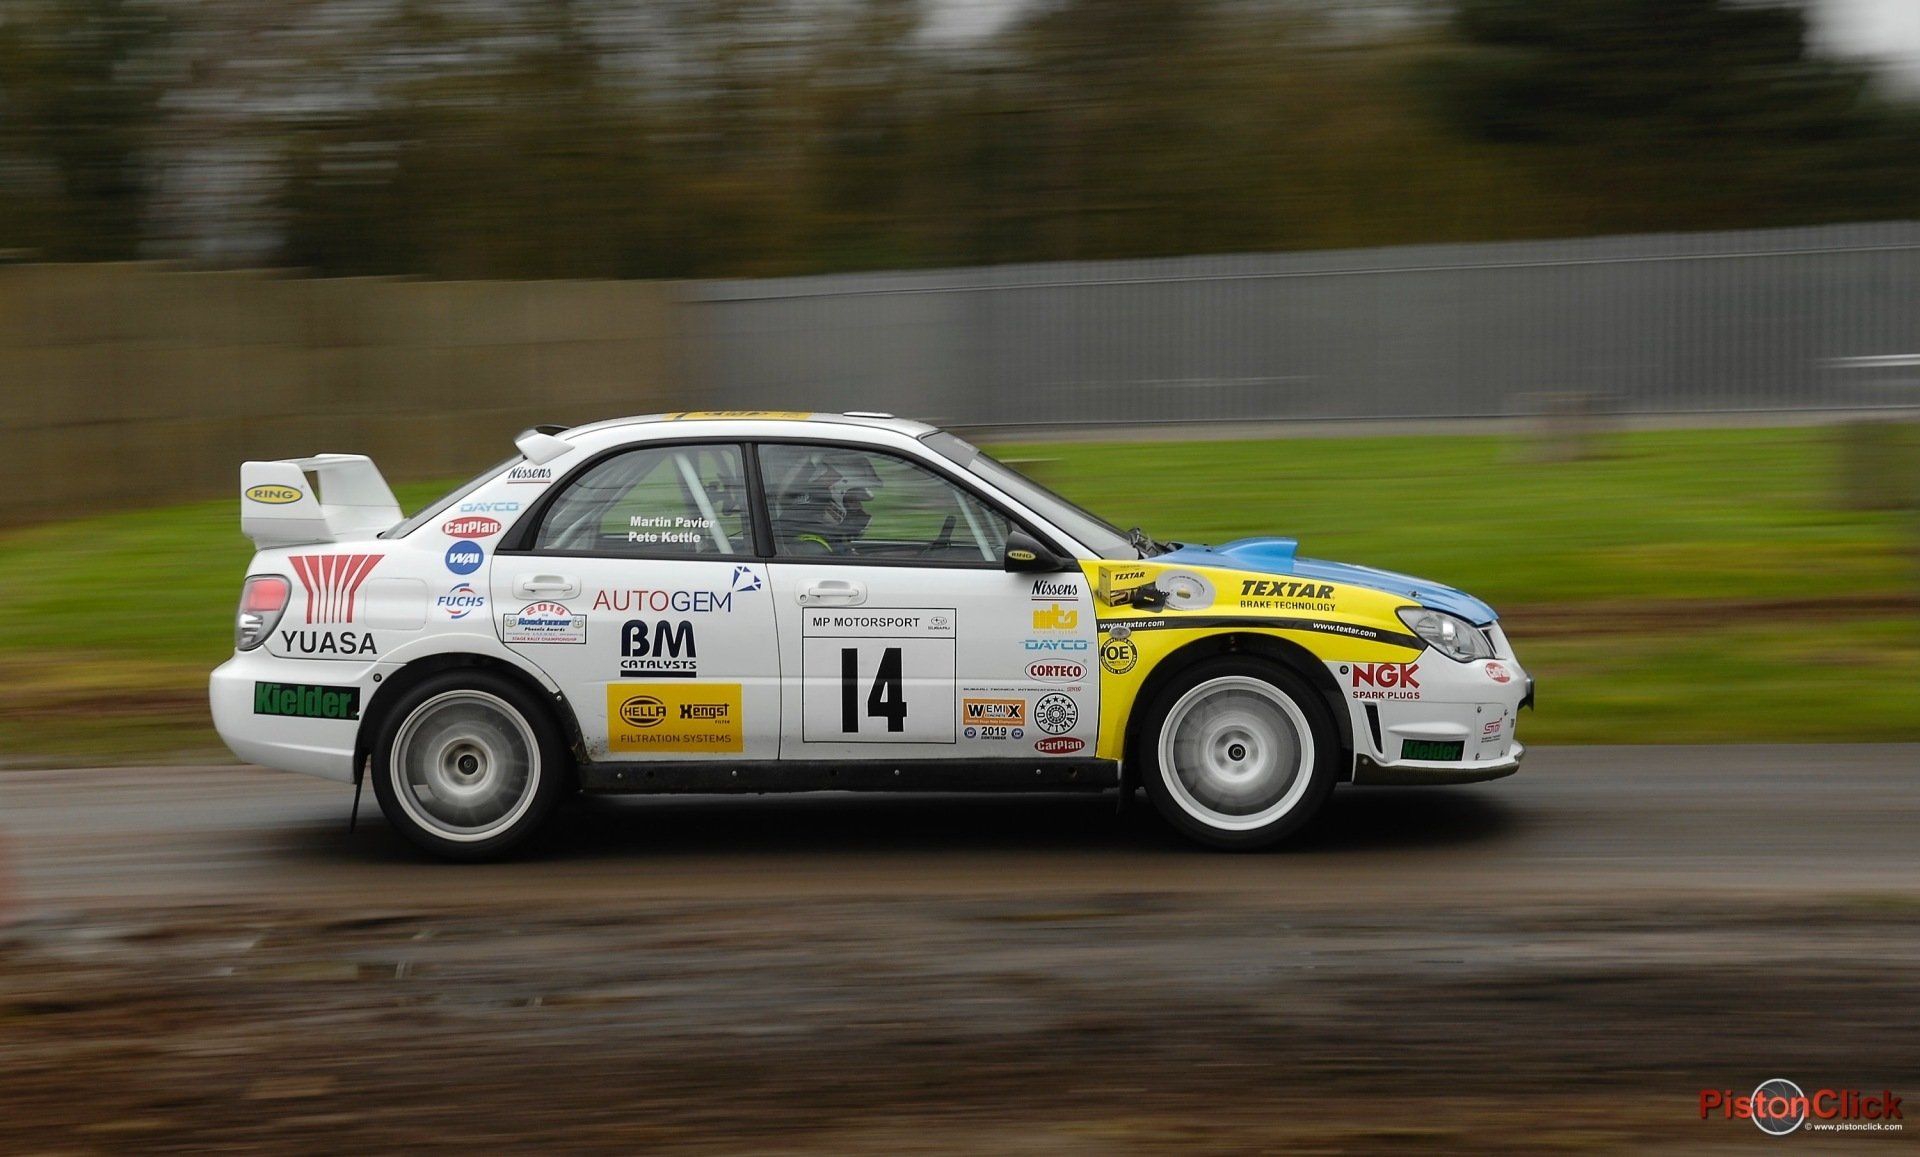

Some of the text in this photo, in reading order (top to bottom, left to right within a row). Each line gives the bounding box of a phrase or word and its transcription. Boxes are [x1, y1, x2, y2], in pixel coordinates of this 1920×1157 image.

[508, 467, 551, 480] Nissens
[254, 490, 294, 500] RING
[460, 502, 519, 513] DAYCO
[444, 519, 499, 536] CarPlan
[630, 516, 716, 529] Martin Pavier
[628, 531, 701, 543] Pete Kettle
[450, 552, 479, 565] WAI
[1011, 551, 1033, 559] RING
[1115, 571, 1146, 580] TEXTAR
[1031, 579, 1078, 596] Nissens
[1241, 580, 1334, 599] TEXTAR
[437, 596, 484, 607] FUCHS
[593, 590, 732, 612] AUTOGEM
[1240, 601, 1336, 612] BRAKE TECHNOLOGY
[526, 603, 565, 616] 2019
[517, 617, 572, 626] Roadrunner
[813, 617, 920, 627] MP MOTORSPORT
[1100, 620, 1165, 630] www.textar.com
[1312, 622, 1377, 638] www.textar.com
[282, 631, 377, 654] YUASA
[621, 620, 697, 658] BM
[1025, 640, 1088, 650] DAYCO
[1106, 646, 1129, 660] OE
[621, 660, 697, 669] CATALYSTS
[1031, 665, 1081, 677] CORTECO
[1352, 663, 1419, 688] NGK
[841, 648, 907, 733] 14
[1352, 690, 1420, 699] SPARK PLUGS
[255, 682, 353, 717] Kielder
[624, 706, 667, 717] HELLA
[680, 703, 729, 719] Hengst
[1036, 710, 1076, 733] OPTIMAL
[981, 727, 1007, 736] 2019
[620, 735, 731, 743] FILTRATION SYSTEMS
[1037, 741, 1082, 751] CarPlan
